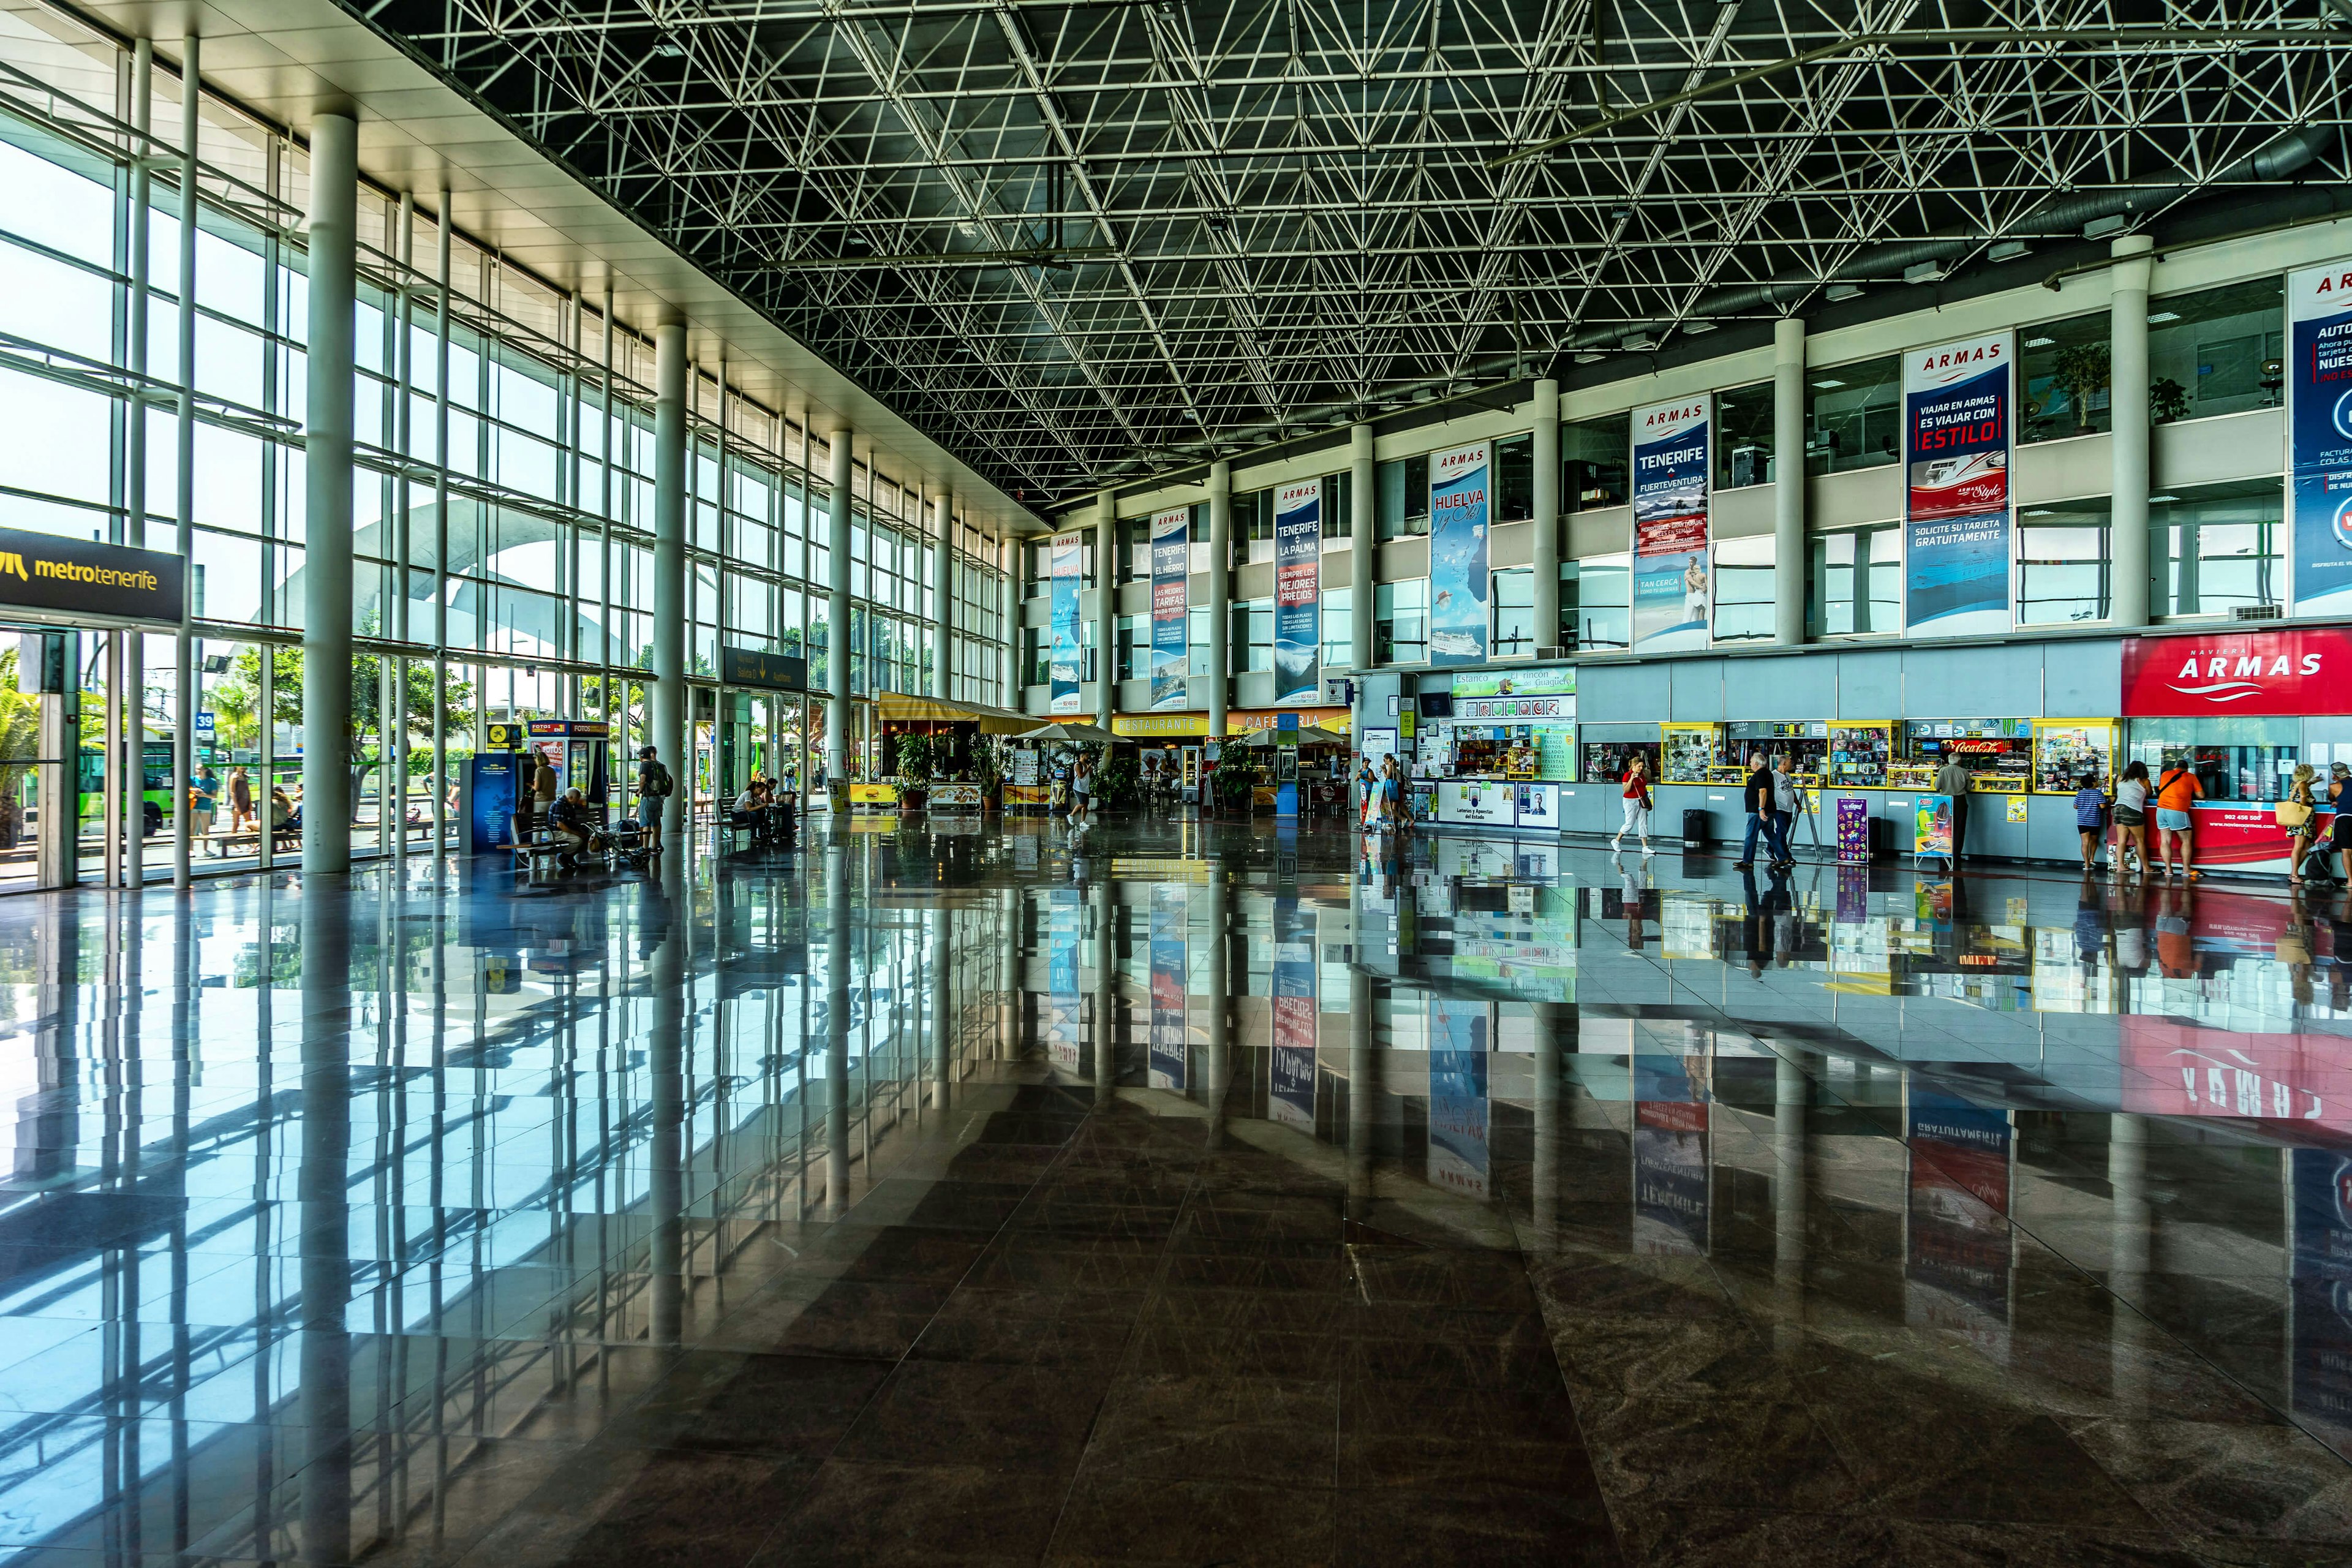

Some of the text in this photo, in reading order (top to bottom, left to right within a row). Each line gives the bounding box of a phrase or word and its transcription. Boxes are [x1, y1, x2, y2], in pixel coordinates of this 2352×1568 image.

[2318, 341, 2342, 350] Ahora
[2318, 346, 2346, 358] tarjeta
[1923, 344, 2001, 371] ARMAS
[1920, 394, 1996, 415] VIAJAR EN ARMAS
[1646, 405, 1702, 426] ARMAS
[1920, 407, 1996, 429] ES VIAJAR CON
[1921, 421, 1995, 450] ESTILO
[1441, 450, 1483, 468] ARMAS
[1639, 446, 1703, 470] TENERIFE
[2320, 456, 2349, 466] COLAS
[1640, 475, 1703, 492] FUERTEVENTURA
[1283, 486, 1316, 500] ARMAS
[1972, 484, 2001, 500] Style
[1435, 490, 1485, 510] HUELVA
[1158, 513, 1185, 526] ARMAS
[1278, 521, 1318, 538] TENERIFE
[1915, 519, 2000, 536] SOLICITE SU TARJETA
[1057, 536, 1079, 547] ARMAS
[1915, 530, 2000, 547] GRATUITAMENTE
[1154, 544, 1186, 559] TENERIFE
[1280, 542, 1316, 556] LA PALMA
[35, 559, 157, 590] metrotenerife
[1054, 564, 1079, 578] HUELVA
[1155, 562, 1184, 575] EL HIERRO
[1280, 568, 1315, 580] SIEMPRE LOS
[1280, 578, 1316, 592] MEJORES
[1656, 578, 1678, 587] CERCA
[1164, 586, 1185, 595] MEJORES
[1282, 590, 1313, 602] PRECIOS
[1156, 595, 1184, 608] TARIFAS
[2190, 647, 2247, 656] NAVIERA
[737, 666, 752, 679] Salida
[2177, 653, 2323, 679] ARMAS
[1456, 674, 1488, 683] Estanco
[1523, 670, 1549, 679] rincón
[1535, 677, 1572, 687] Guagüero
[197, 715, 213, 728] 39
[1118, 718, 1195, 731] RESTAURANTE
[1246, 714, 1320, 729] CAFERIA
[542, 745, 563, 754] FOTOS
